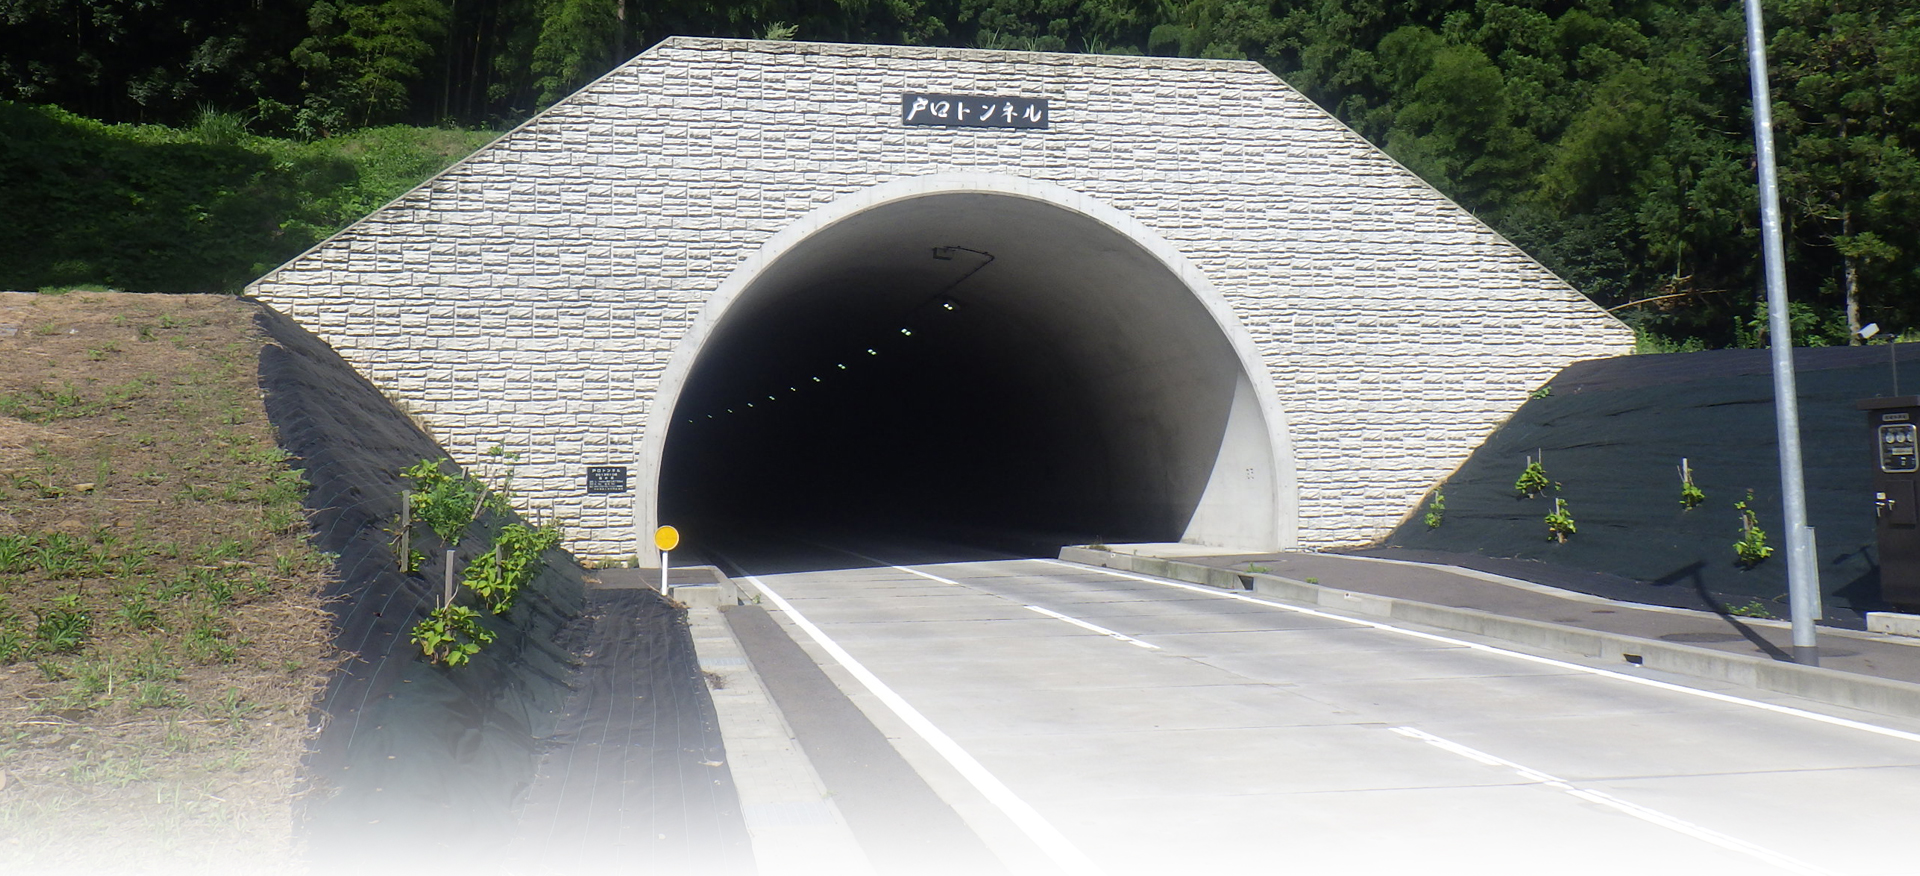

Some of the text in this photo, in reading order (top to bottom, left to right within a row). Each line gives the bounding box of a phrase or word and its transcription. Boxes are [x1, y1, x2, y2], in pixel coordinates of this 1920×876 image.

[906, 96, 1042, 123] 戸口トンネル
